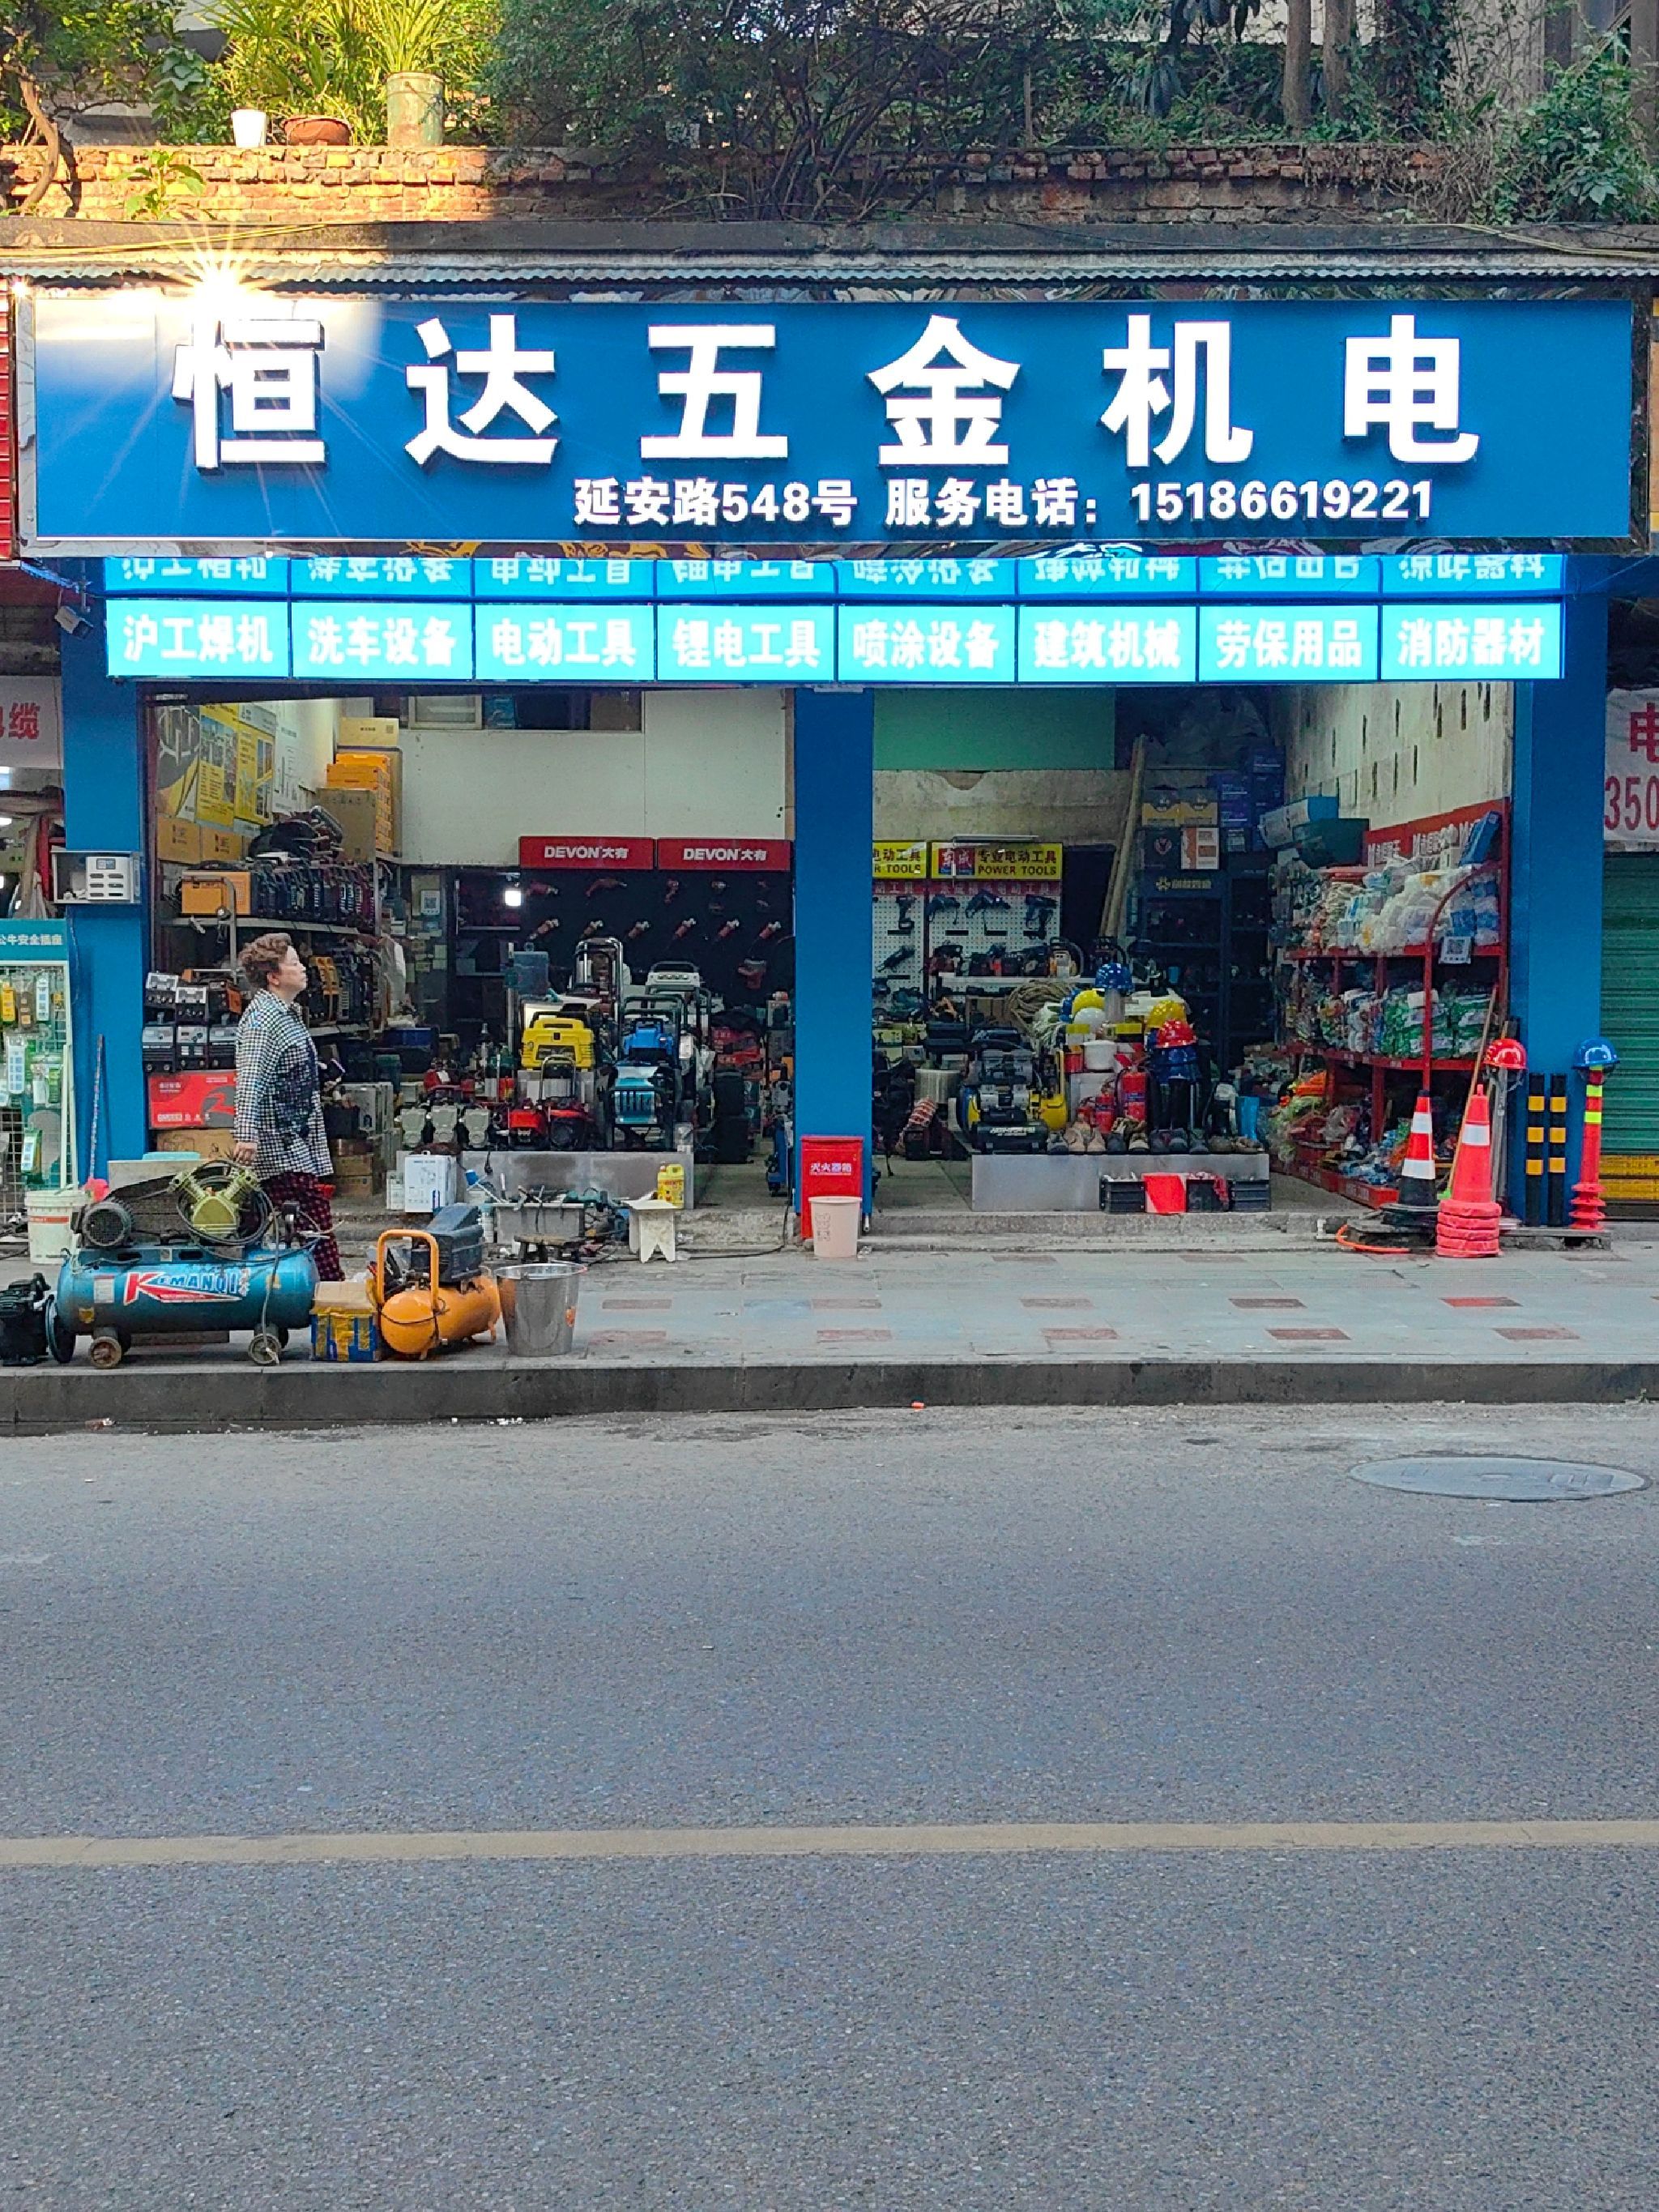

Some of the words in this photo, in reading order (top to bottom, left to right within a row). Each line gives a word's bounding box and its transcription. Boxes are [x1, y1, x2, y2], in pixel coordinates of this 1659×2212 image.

[172, 314, 1479, 468] 恒达五金机电
[574, 476, 858, 526] 延安路548号
[1131, 479, 1432, 522] 15186619221
[122, 613, 273, 663] 沪工焊机
[307, 616, 457, 667] 洗车设备
[492, 617, 638, 667] 电动工具
[672, 618, 821, 668] 锂电工具
[852, 619, 1000, 668] 喷涂设备
[1034, 619, 1182, 668] 建筑机械
[1215, 619, 1363, 668] 劳保用品
[1397, 617, 1545, 667] 消防器材
[0, 702, 41, 740] 缆
[544, 846, 600, 859] DEVON
[602, 847, 629, 859] 大有
[683, 848, 739, 860] DEVON
[740, 848, 767, 860] 大有
[978, 865, 1016, 875] POWER
[1022, 865, 1056, 875] TOOLS
